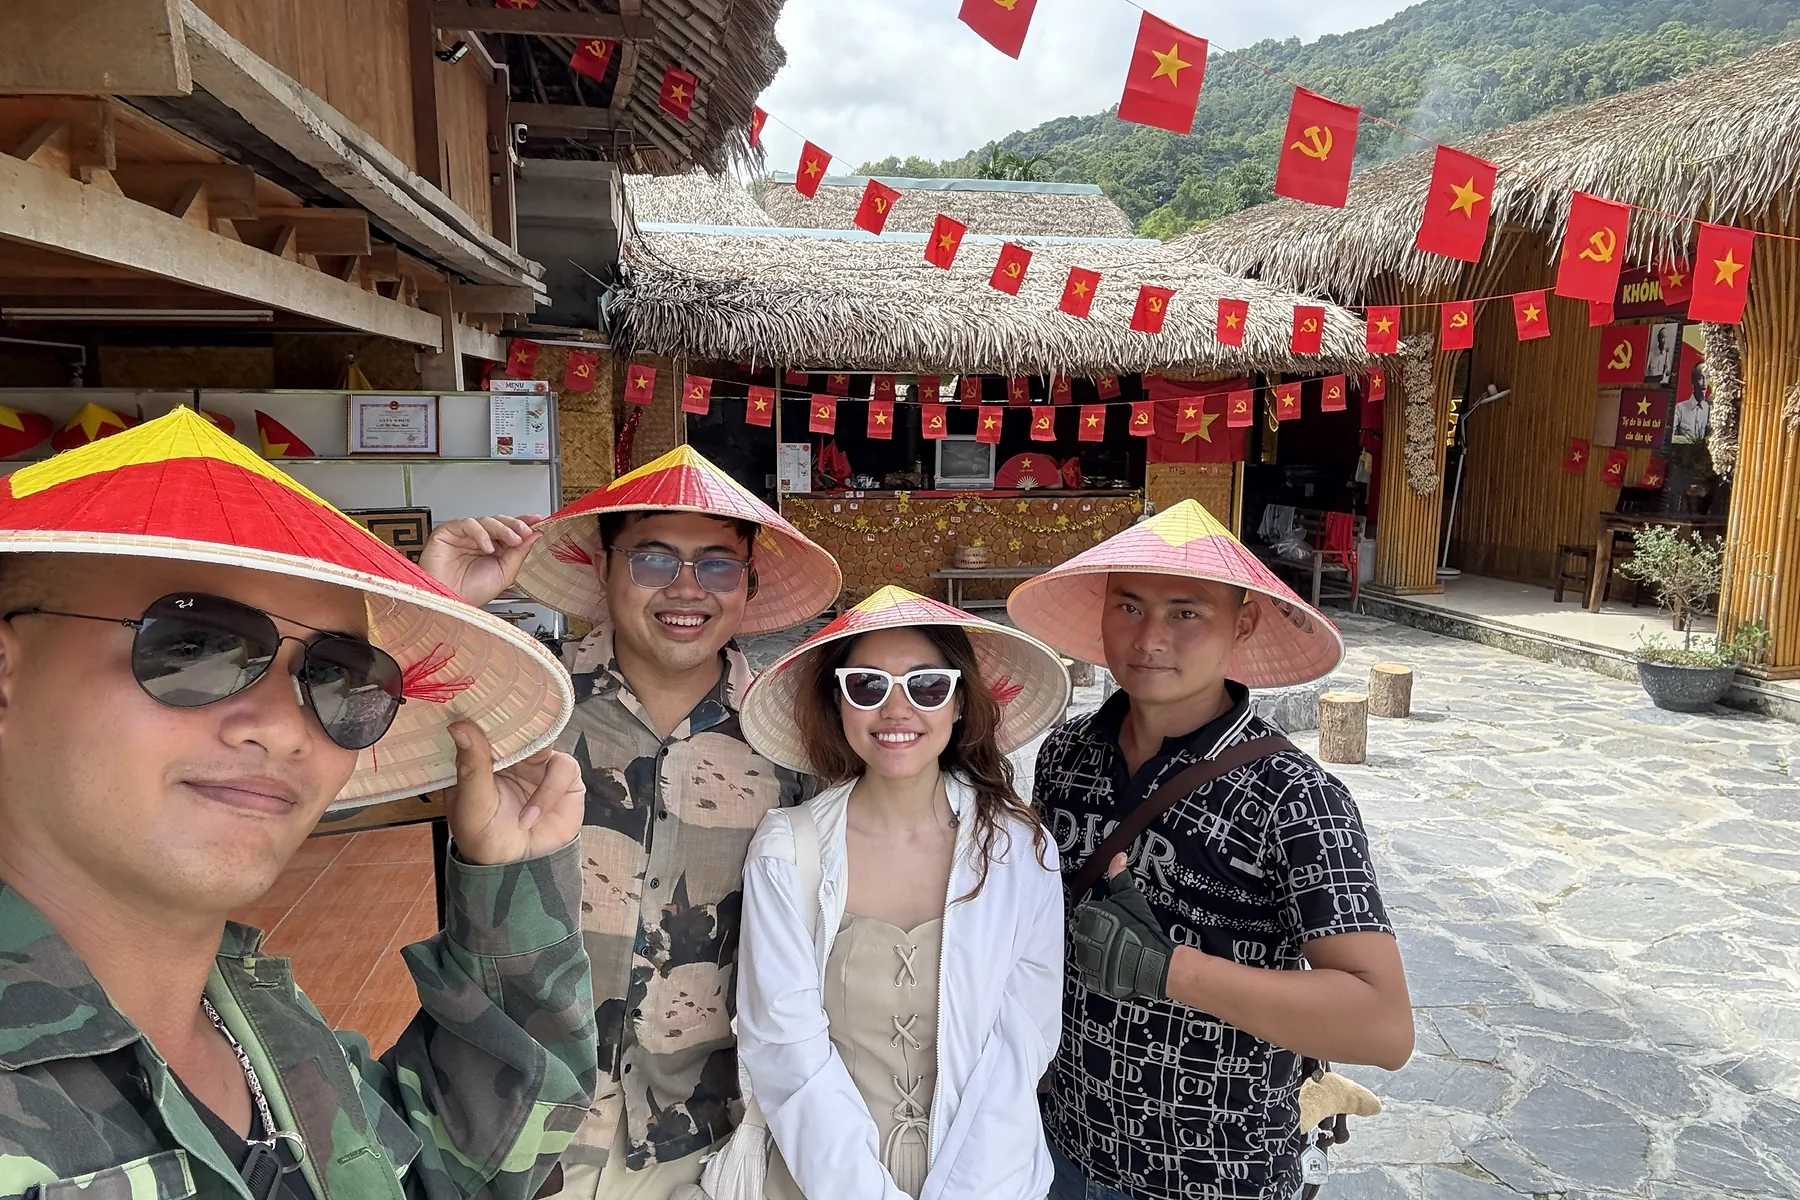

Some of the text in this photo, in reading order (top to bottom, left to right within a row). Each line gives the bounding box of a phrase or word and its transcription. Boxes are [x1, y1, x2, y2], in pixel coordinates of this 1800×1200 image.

[1622, 277, 1664, 304] KHÔN
[1271, 756, 1304, 777] CD
[1241, 801, 1268, 828] CD
[1273, 801, 1308, 825] CD
[1198, 813, 1232, 841] CD
[1319, 829, 1354, 849] CD
[1289, 863, 1324, 889] CD
[1333, 893, 1370, 915] CD
[1169, 923, 1201, 947] CD
[1235, 940, 1267, 961] CD
[1117, 1001, 1150, 1025] CD
[1084, 1019, 1112, 1045] CD
[1187, 1019, 1221, 1042] CD
[1147, 1041, 1179, 1065] CD
[1217, 1055, 1251, 1074] CD
[1112, 1059, 1143, 1084] CD
[1084, 1075, 1109, 1102] CD
[1179, 1075, 1214, 1097] CD
[1143, 1099, 1175, 1119] CD
[1114, 1115, 1145, 1137] CD
[1178, 1127, 1212, 1148] CD
[1089, 1130, 1115, 1155] CD
[1147, 1153, 1180, 1172] CD
[1184, 1181, 1220, 1200] CD
